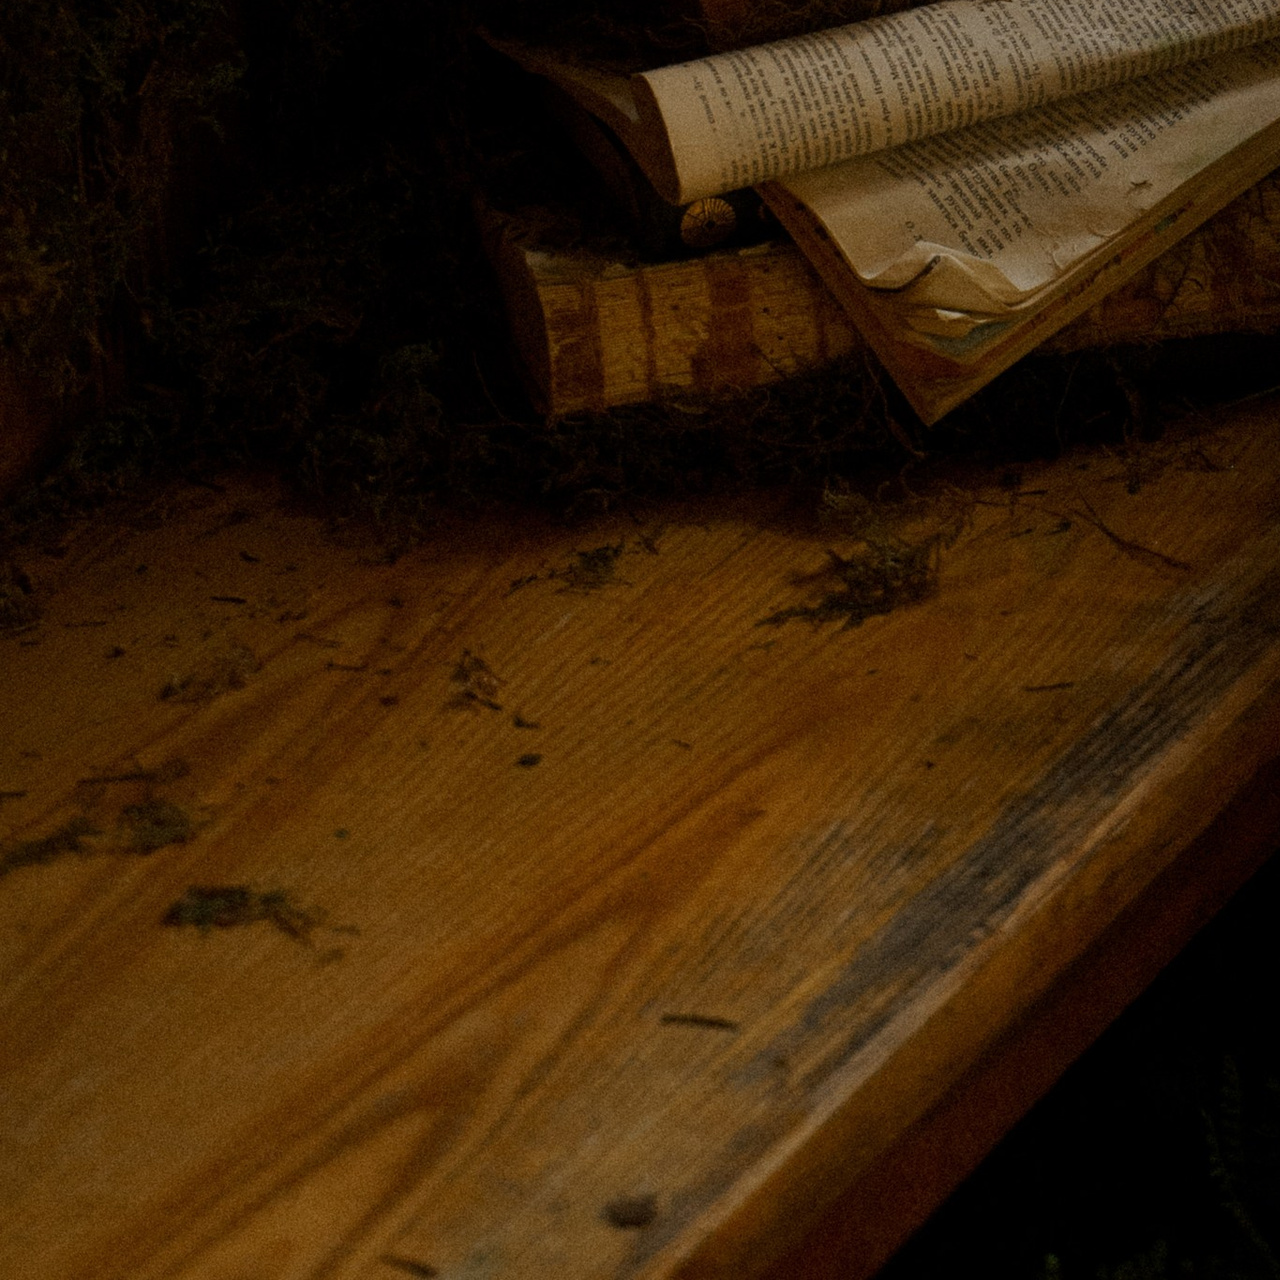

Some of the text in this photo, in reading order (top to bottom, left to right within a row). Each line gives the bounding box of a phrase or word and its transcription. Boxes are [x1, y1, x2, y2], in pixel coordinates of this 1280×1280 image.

[1107, 136, 1130, 161] раза
[924, 186, 960, 231] заняться
[943, 192, 976, 232] русское
[984, 226, 1006, 252] соли
